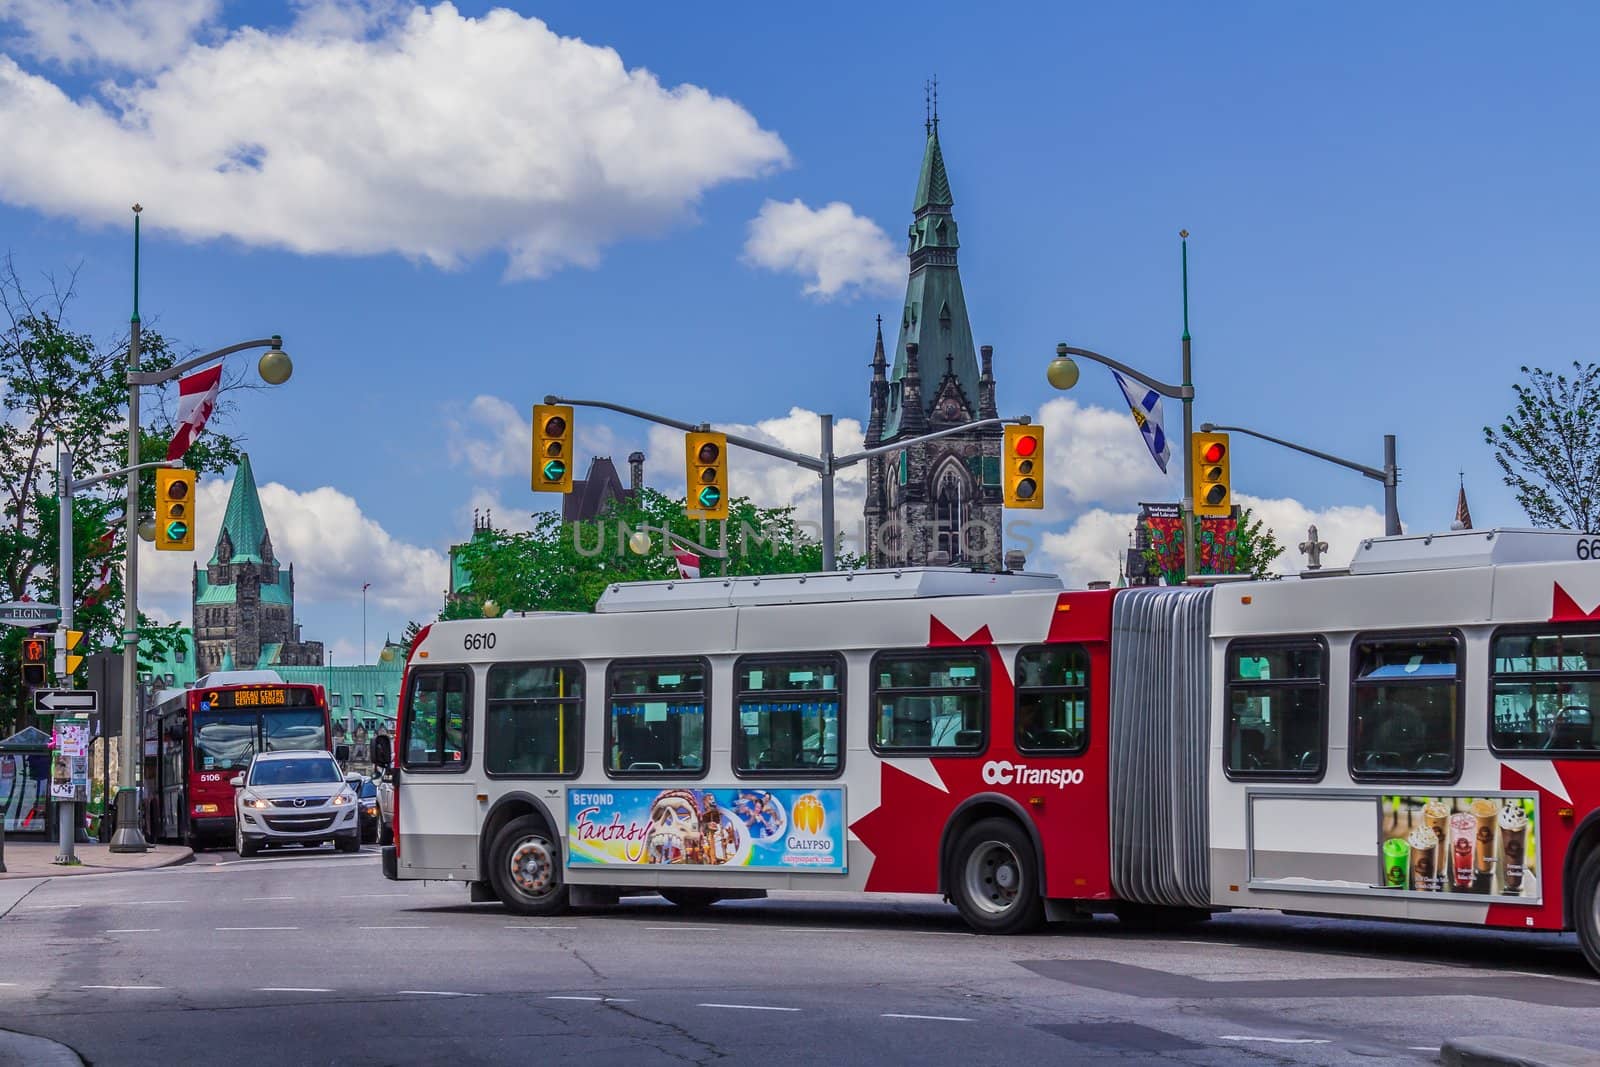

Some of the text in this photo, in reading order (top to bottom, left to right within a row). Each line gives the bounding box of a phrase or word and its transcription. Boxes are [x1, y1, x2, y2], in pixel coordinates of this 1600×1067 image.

[1577, 538, 1600, 560] 66
[13, 608, 41, 618] ELGIN
[464, 632, 497, 650] 6610
[209, 692, 219, 707] 2
[260, 690, 284, 698] CENTRE
[235, 697, 284, 706] CENTRE RIDEAU
[201, 774, 220, 782] 5106
[982, 760, 1084, 789] OC Transpo
[573, 793, 614, 805] BEYOND
[576, 807, 653, 862] Fantasy
